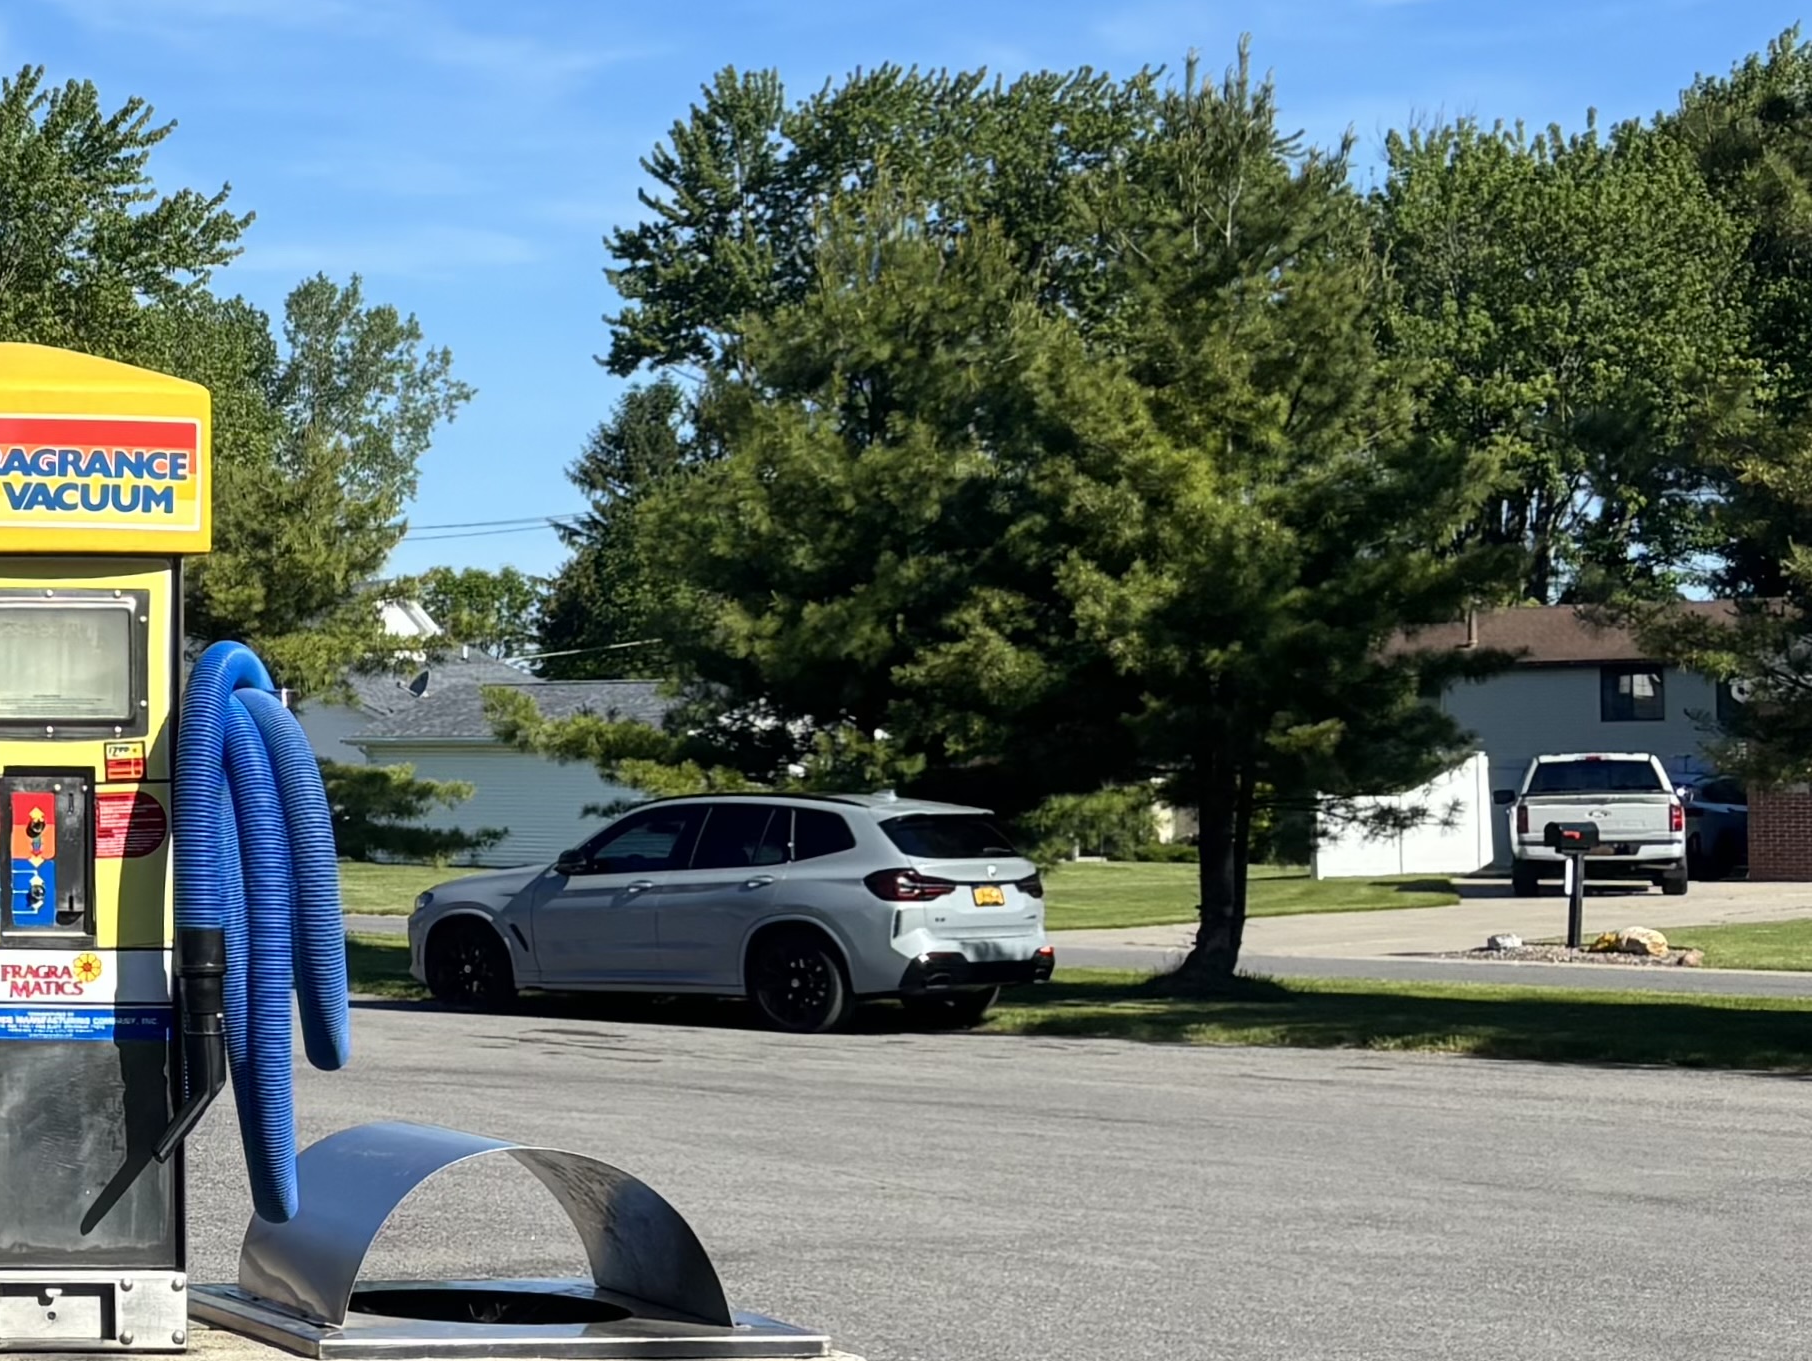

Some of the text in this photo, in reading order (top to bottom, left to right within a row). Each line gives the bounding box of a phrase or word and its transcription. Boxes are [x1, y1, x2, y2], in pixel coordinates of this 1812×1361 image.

[2, 482, 174, 514] VACUUM
[0, 964, 74, 983] FRAGRA
[9, 980, 85, 999] MATICS
